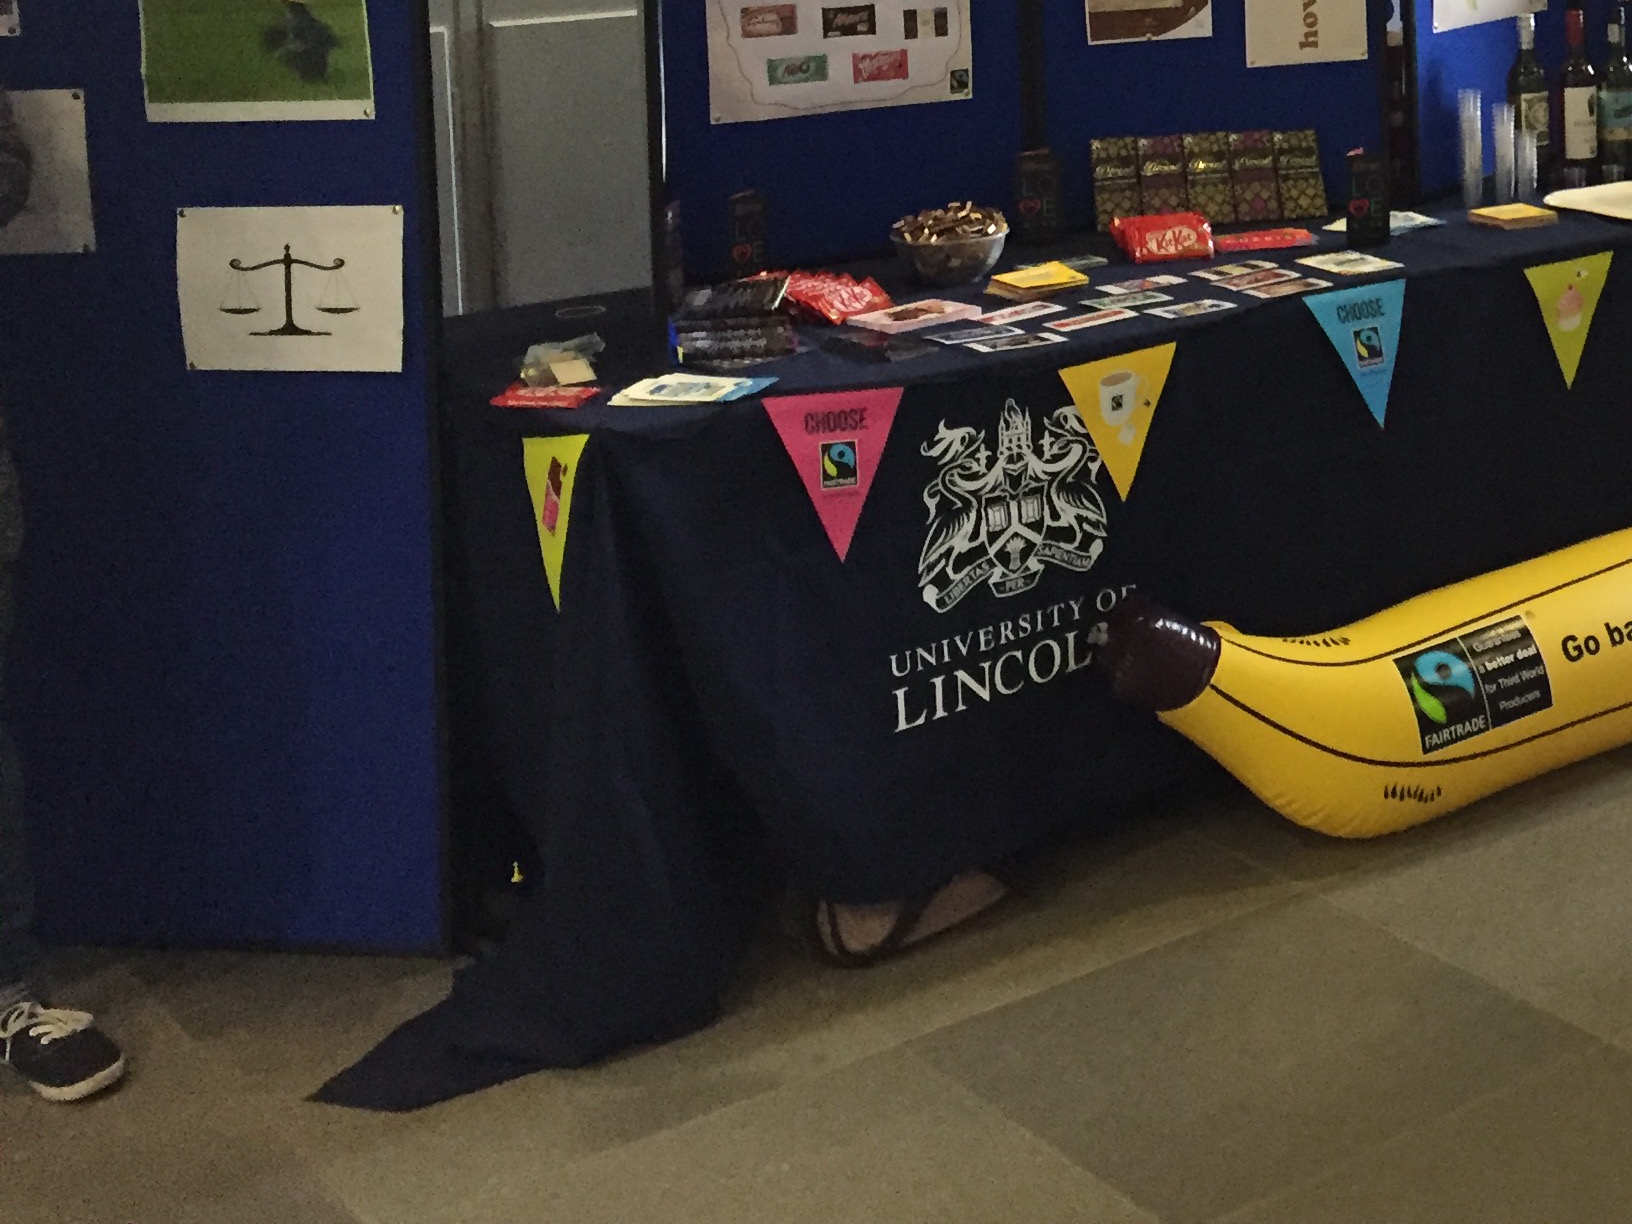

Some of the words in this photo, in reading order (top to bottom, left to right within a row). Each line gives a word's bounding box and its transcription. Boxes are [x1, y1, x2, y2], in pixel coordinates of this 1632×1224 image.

[1336, 297, 1385, 324] CHOOSE
[804, 407, 869, 435] CHOOSE
[890, 595, 1085, 677] UNIVERSITY
[1561, 634, 1601, 663] Go
[1485, 652, 1515, 672] better
[1516, 643, 1538, 660] deal
[892, 626, 1100, 733] LINCOL
[1485, 680, 1497, 694] for
[1522, 664, 1546, 682] World
[1499, 689, 1542, 711] Producers
[1424, 714, 1487, 749] FAIRTRADE
